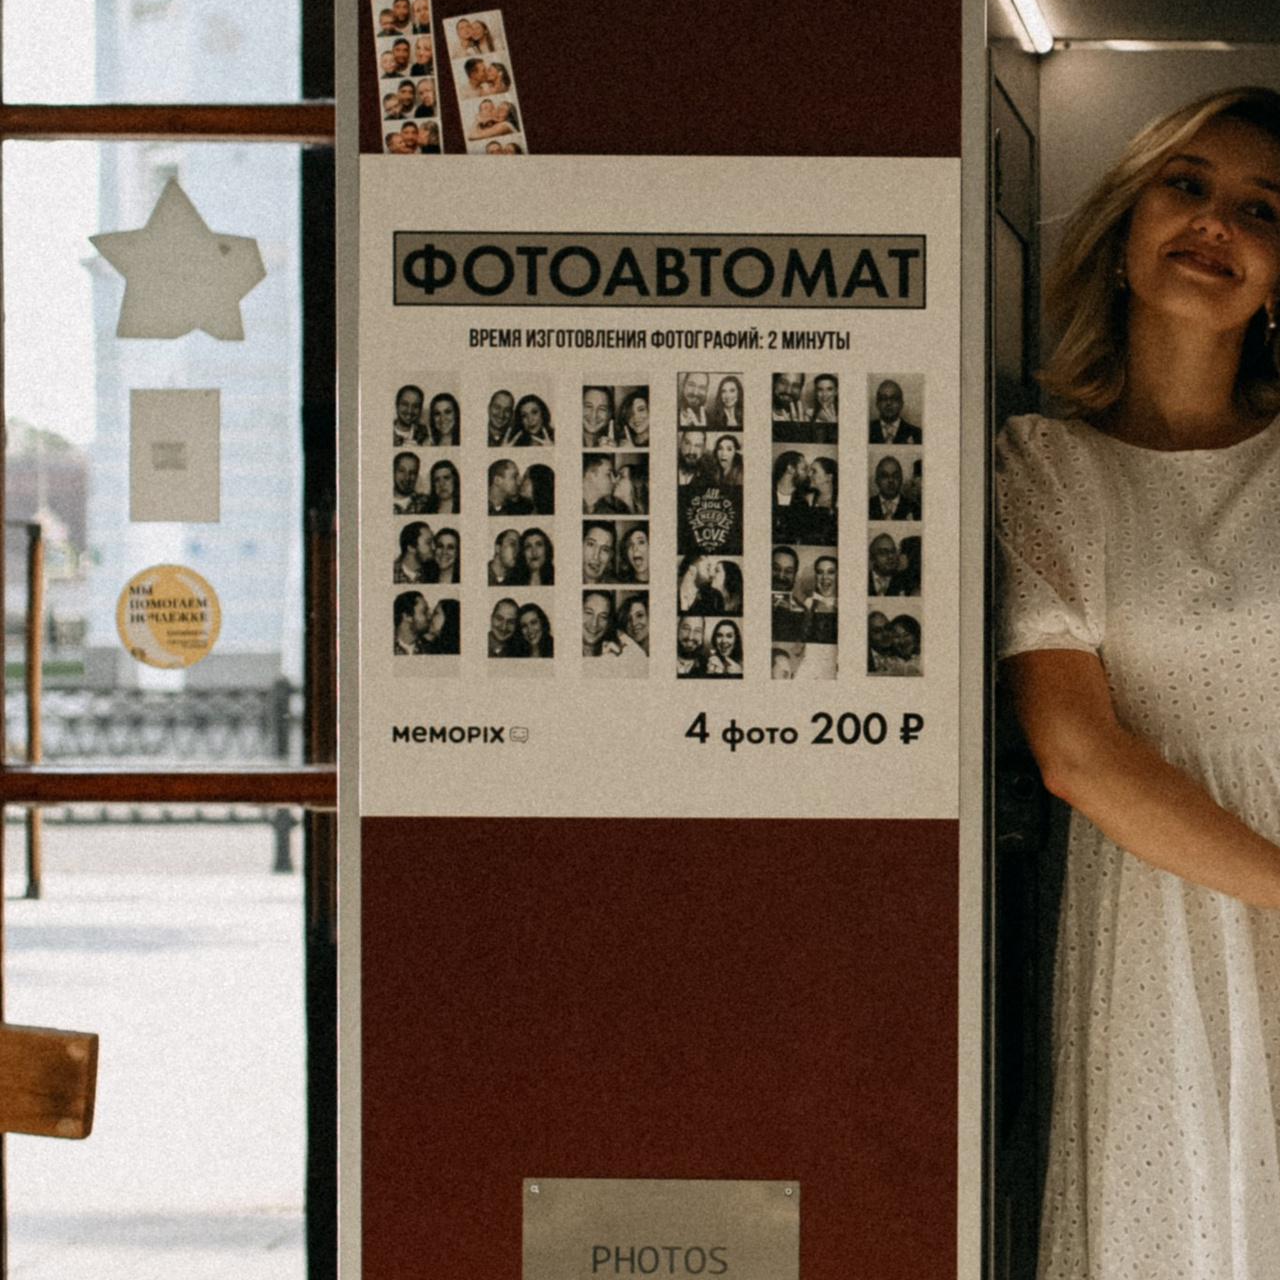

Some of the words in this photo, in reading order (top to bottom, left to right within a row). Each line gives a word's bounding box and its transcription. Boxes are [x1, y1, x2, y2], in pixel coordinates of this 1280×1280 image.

[401, 243, 920, 299] ФОТОАВТОМАТ
[469, 328, 522, 348] ВРЕМЯ
[526, 328, 647, 349] ИЗГОТОВЛЕНИЯ
[651, 326, 764, 350] ФОТОГРАФИЙ:
[768, 330, 777, 350] 2
[782, 330, 850, 351] МИНУТЫ
[694, 528, 729, 543] LOVE
[685, 712, 710, 744] 4
[722, 719, 798, 752] фото
[811, 712, 888, 745] 200
[591, 1245, 729, 1274] PHOTOS
